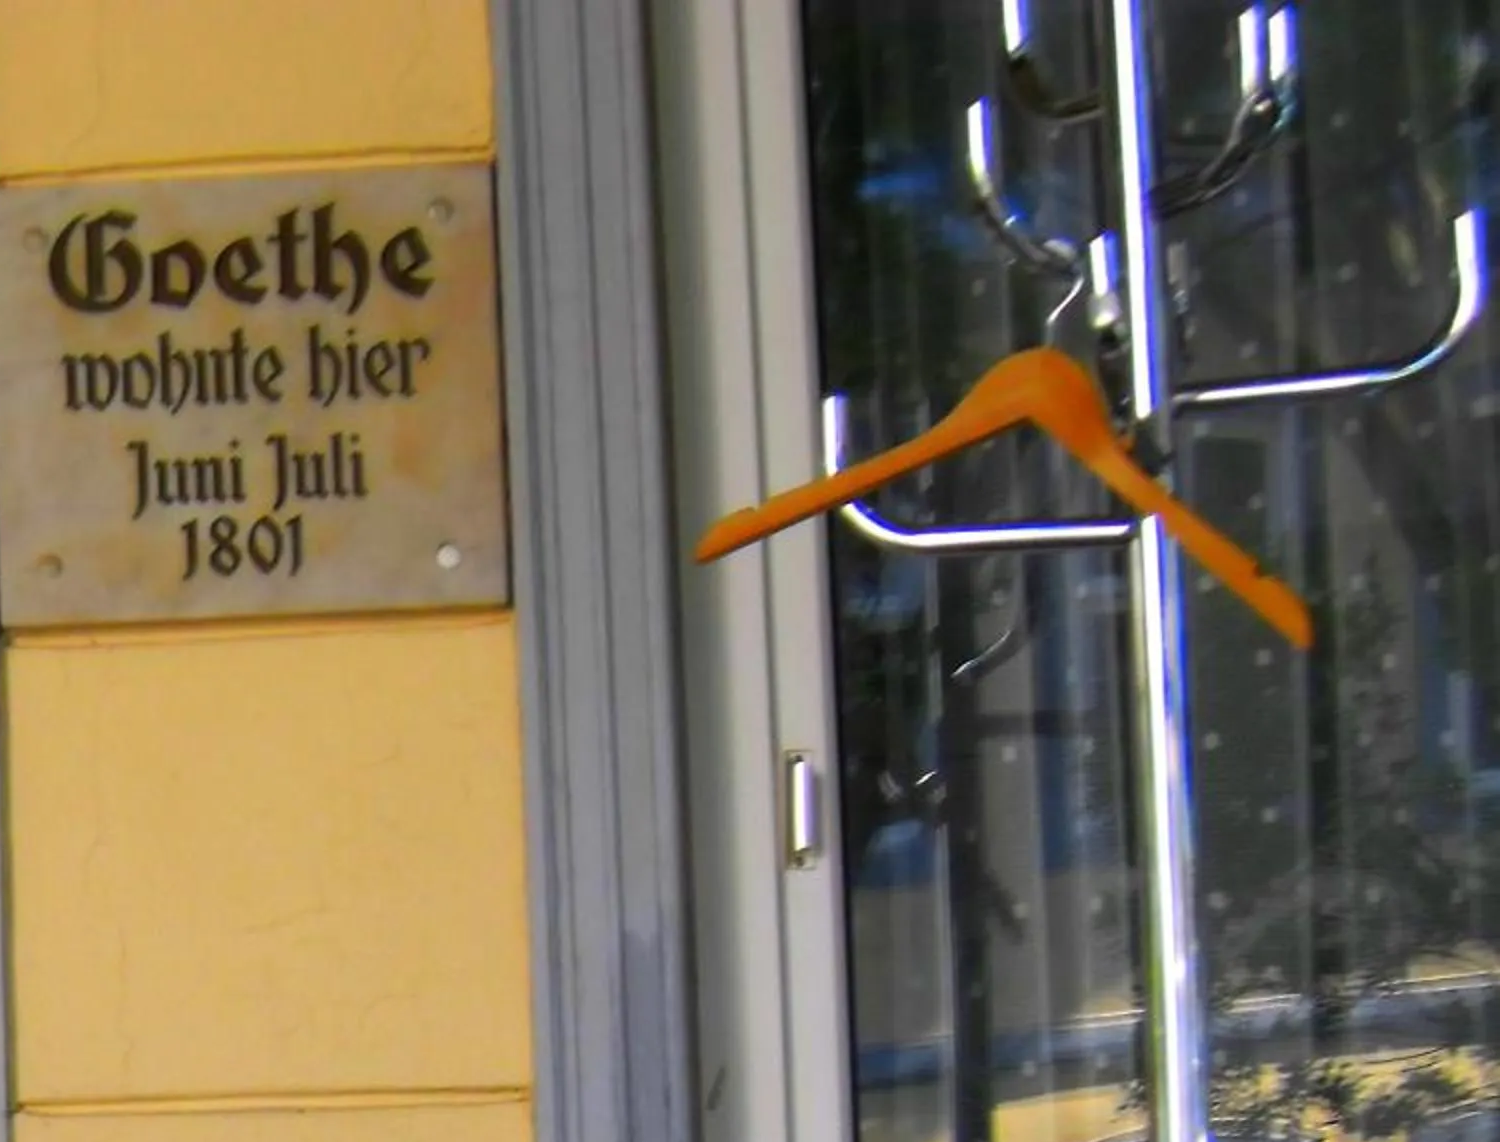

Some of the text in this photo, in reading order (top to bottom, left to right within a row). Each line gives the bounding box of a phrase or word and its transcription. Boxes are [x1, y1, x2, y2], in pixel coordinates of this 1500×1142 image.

[47, 200, 435, 315] Goethe
[60, 325, 432, 415] wohnte hier
[125, 431, 369, 521] Juni Juli
[179, 513, 304, 582] 1801
